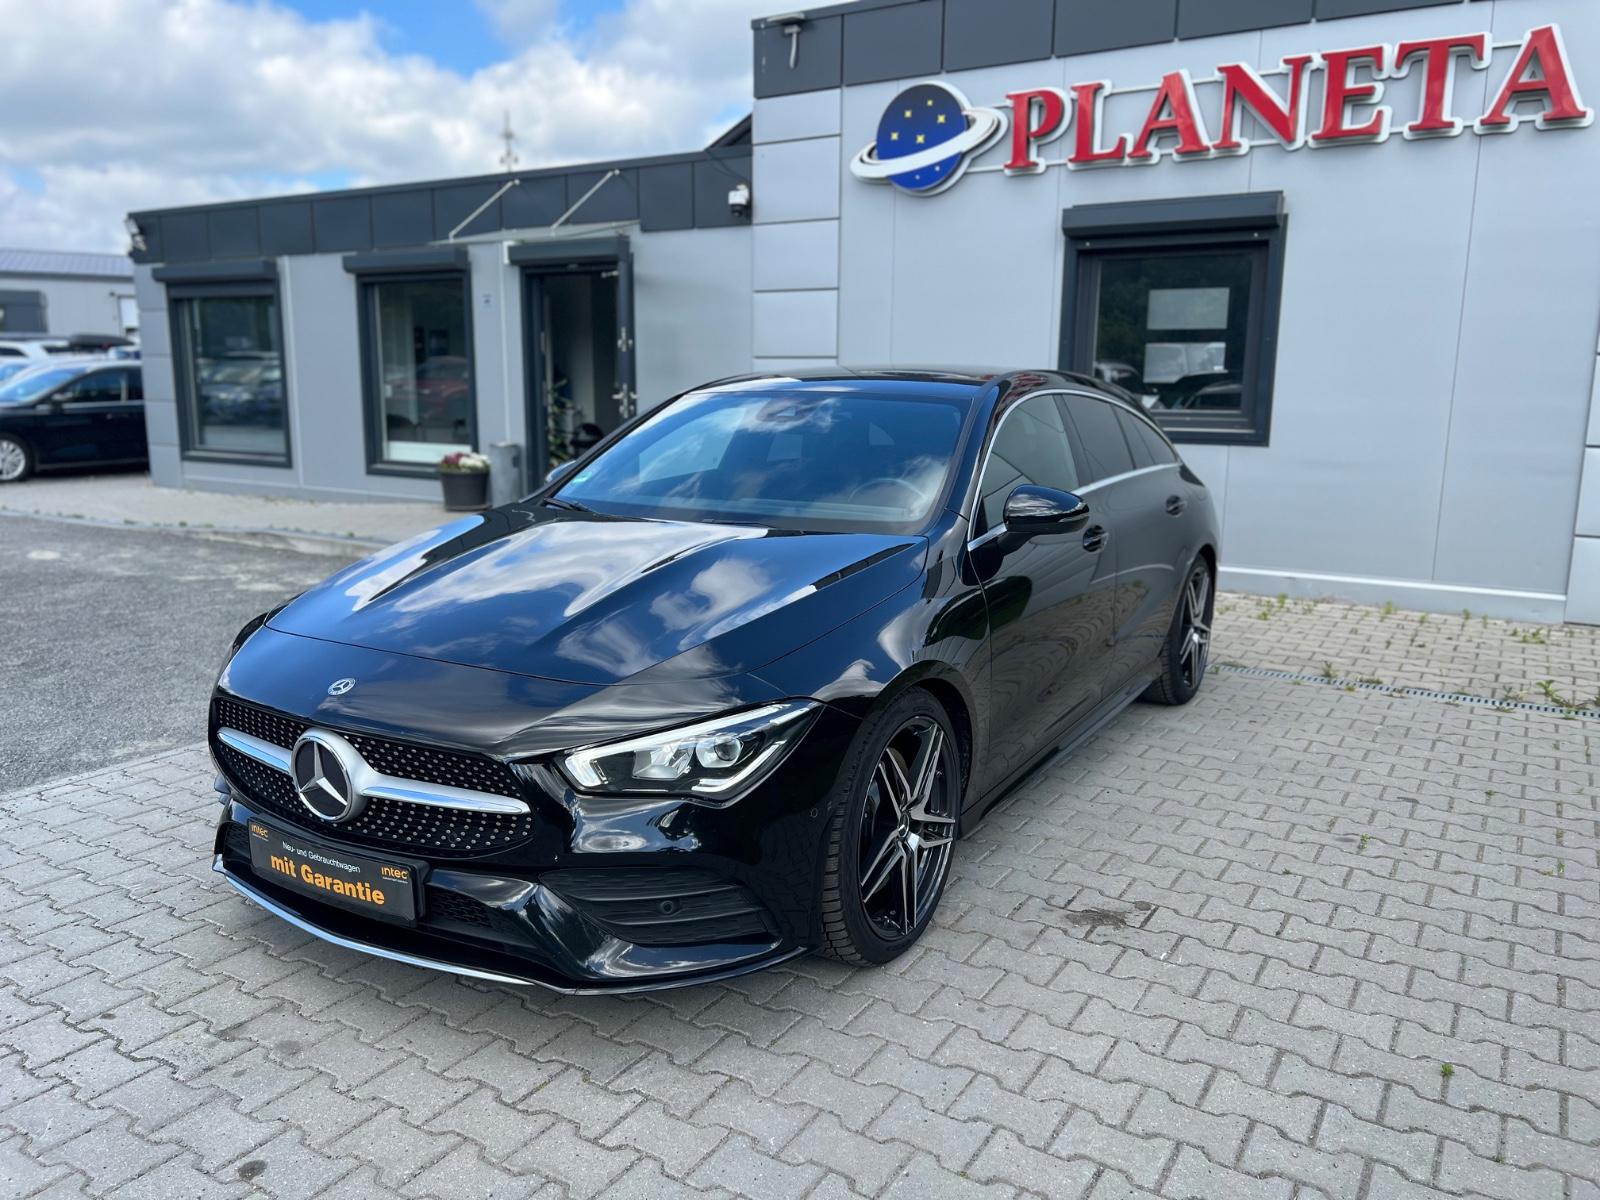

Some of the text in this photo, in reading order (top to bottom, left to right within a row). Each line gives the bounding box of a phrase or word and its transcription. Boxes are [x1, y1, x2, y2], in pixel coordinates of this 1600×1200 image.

[1003, 25, 1590, 170] PLANETA
[296, 848, 308, 858] und
[308, 851, 361, 873] Gebrauchtwagen
[381, 866, 409, 880] intec
[270, 855, 385, 905] mit Garantie
